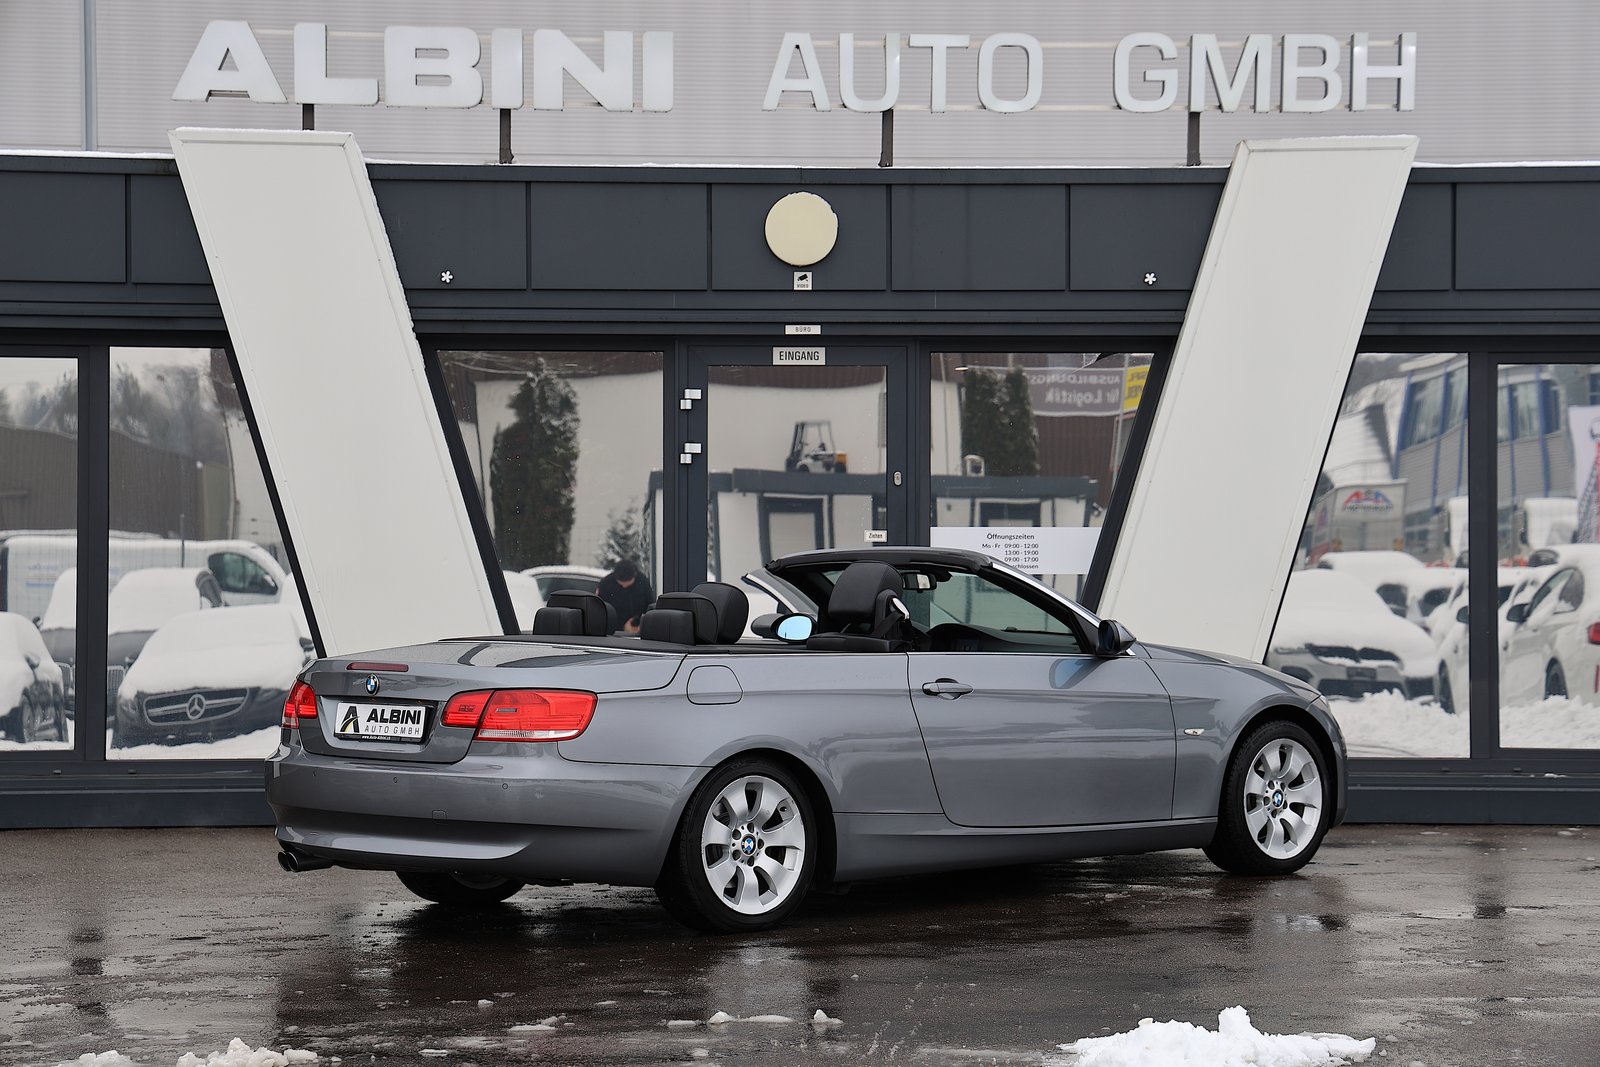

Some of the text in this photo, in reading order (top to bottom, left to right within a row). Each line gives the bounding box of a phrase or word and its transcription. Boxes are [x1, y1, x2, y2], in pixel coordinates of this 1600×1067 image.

[171, 20, 1418, 113] ALBINI AUTO GMBH
[779, 350, 820, 361] EINGANG
[986, 532, 1034, 540] Öffnungszeiten
[366, 708, 422, 725] ALBINI
[364, 725, 389, 734] AUTO
